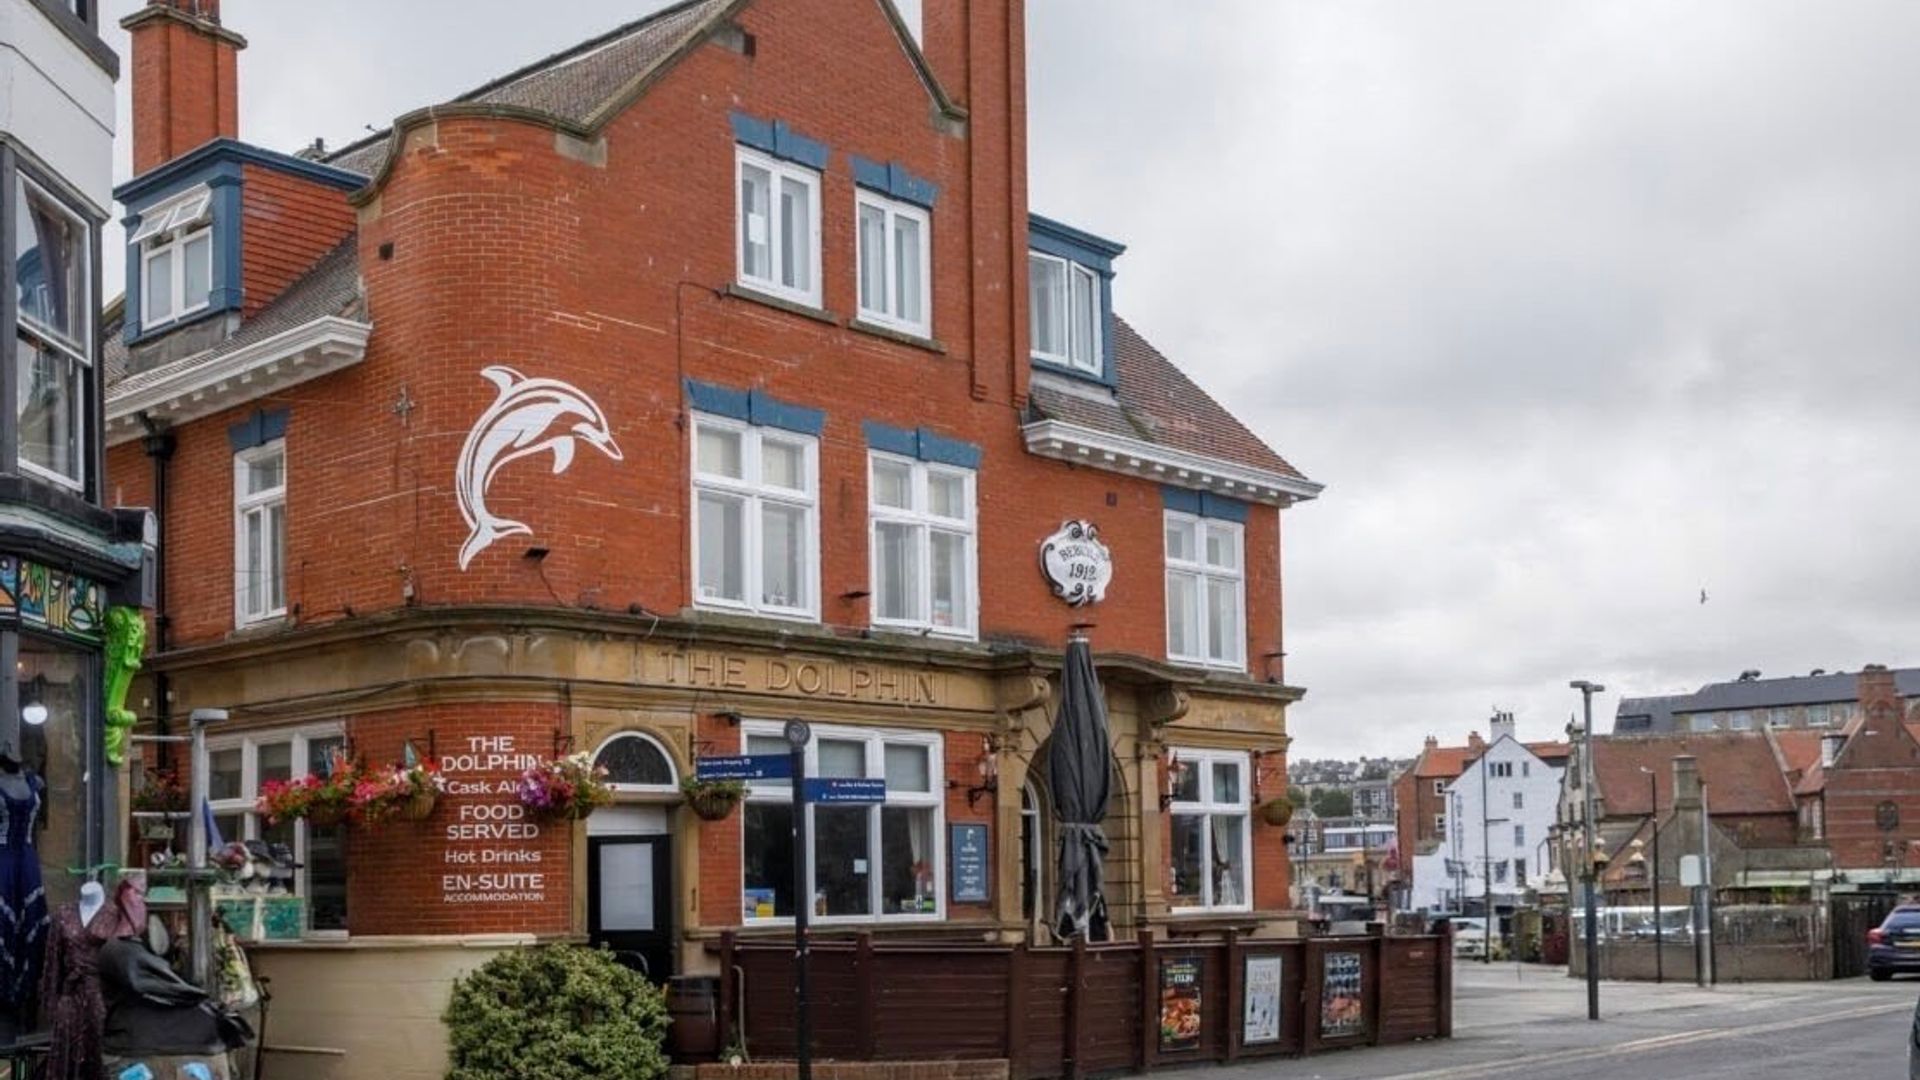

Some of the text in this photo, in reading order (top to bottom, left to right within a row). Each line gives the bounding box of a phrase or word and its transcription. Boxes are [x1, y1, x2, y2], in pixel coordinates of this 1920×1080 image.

[1069, 562, 1097, 580] 1912
[659, 651, 936, 704] THE DOLPHIN
[467, 735, 515, 753] THE
[449, 781, 492, 795] Cask
[460, 804, 524, 821] FOOD
[447, 823, 539, 840] SERVED
[445, 850, 542, 864] Hot Drinks
[443, 873, 544, 891] EN-SUITE
[444, 892, 544, 902] ACCOMMODATION
